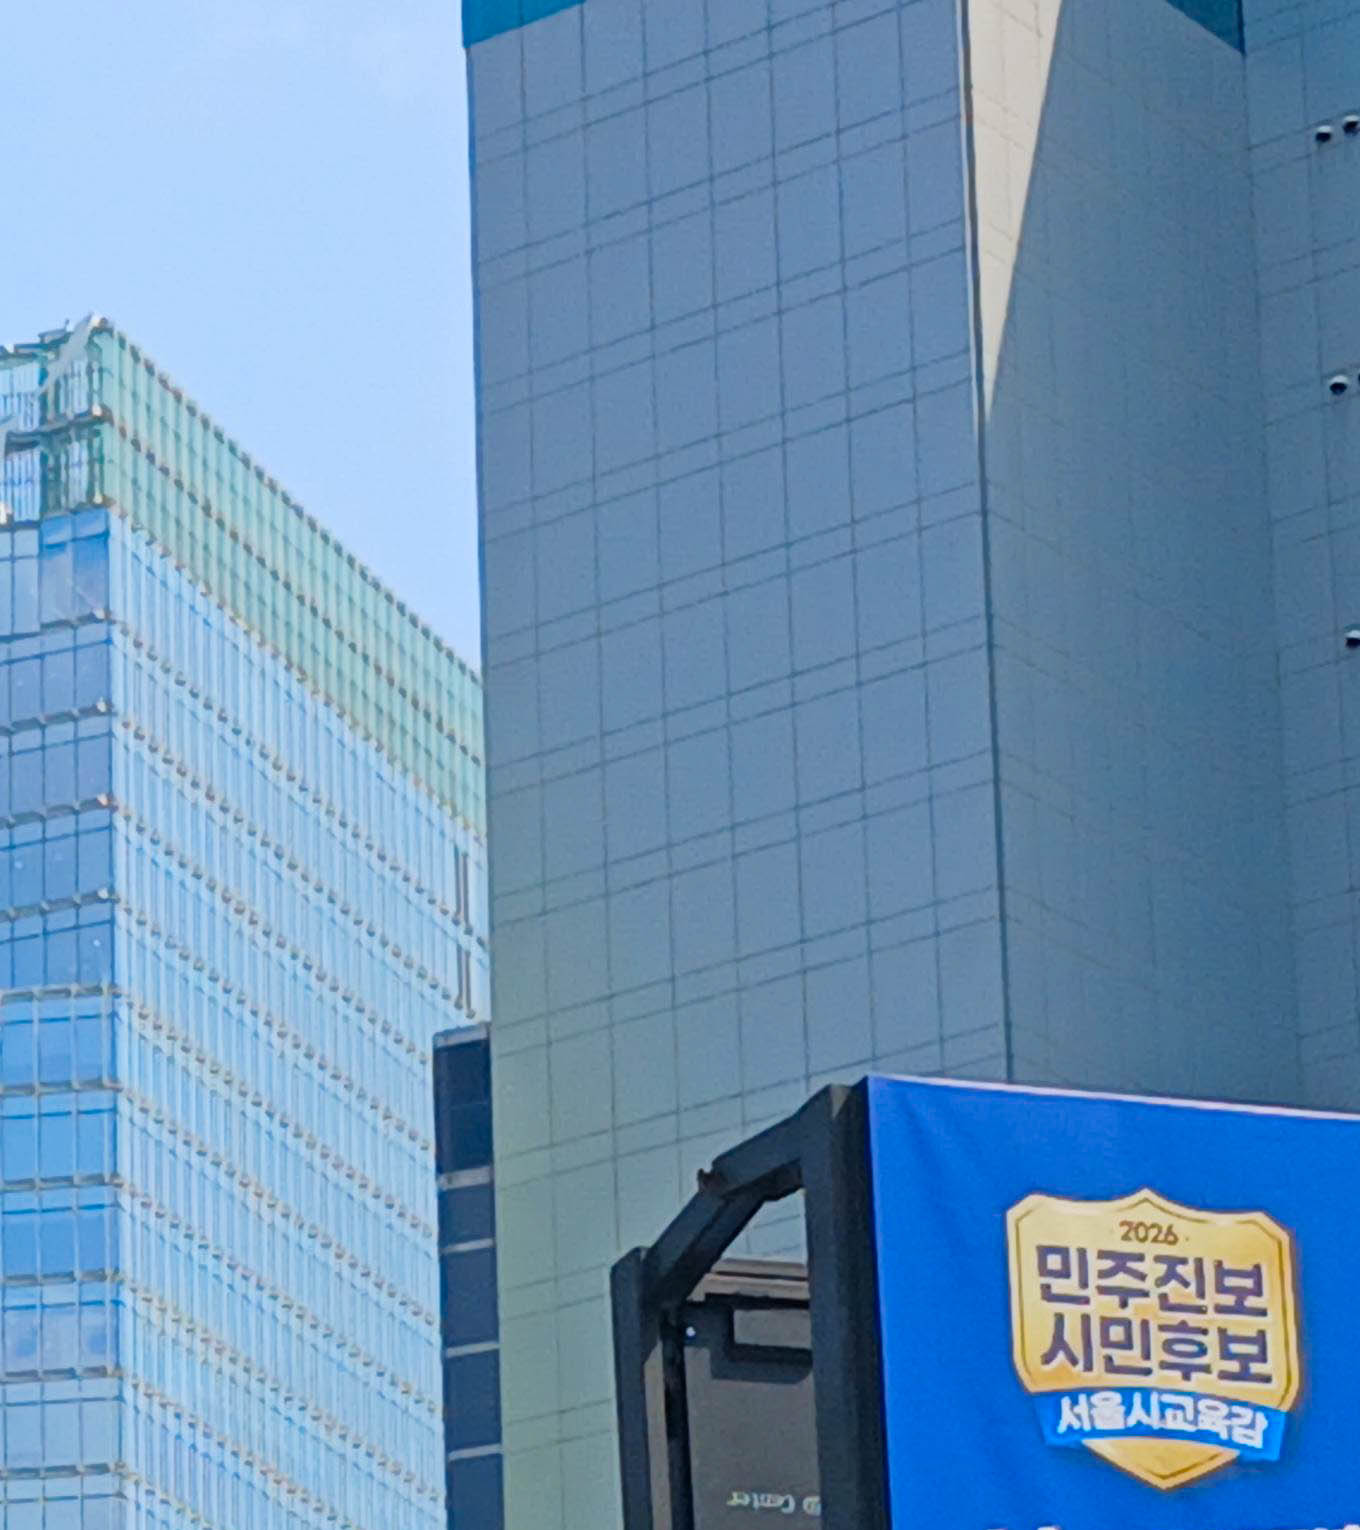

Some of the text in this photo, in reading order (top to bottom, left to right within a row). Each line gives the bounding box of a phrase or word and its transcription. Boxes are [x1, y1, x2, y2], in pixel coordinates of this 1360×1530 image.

[1118, 1220, 1180, 1246] 2026
[1035, 1244, 1269, 1318] 민주진보
[1040, 1312, 1273, 1384] 시민후보
[1056, 1390, 1269, 1449] 서울시교육감
